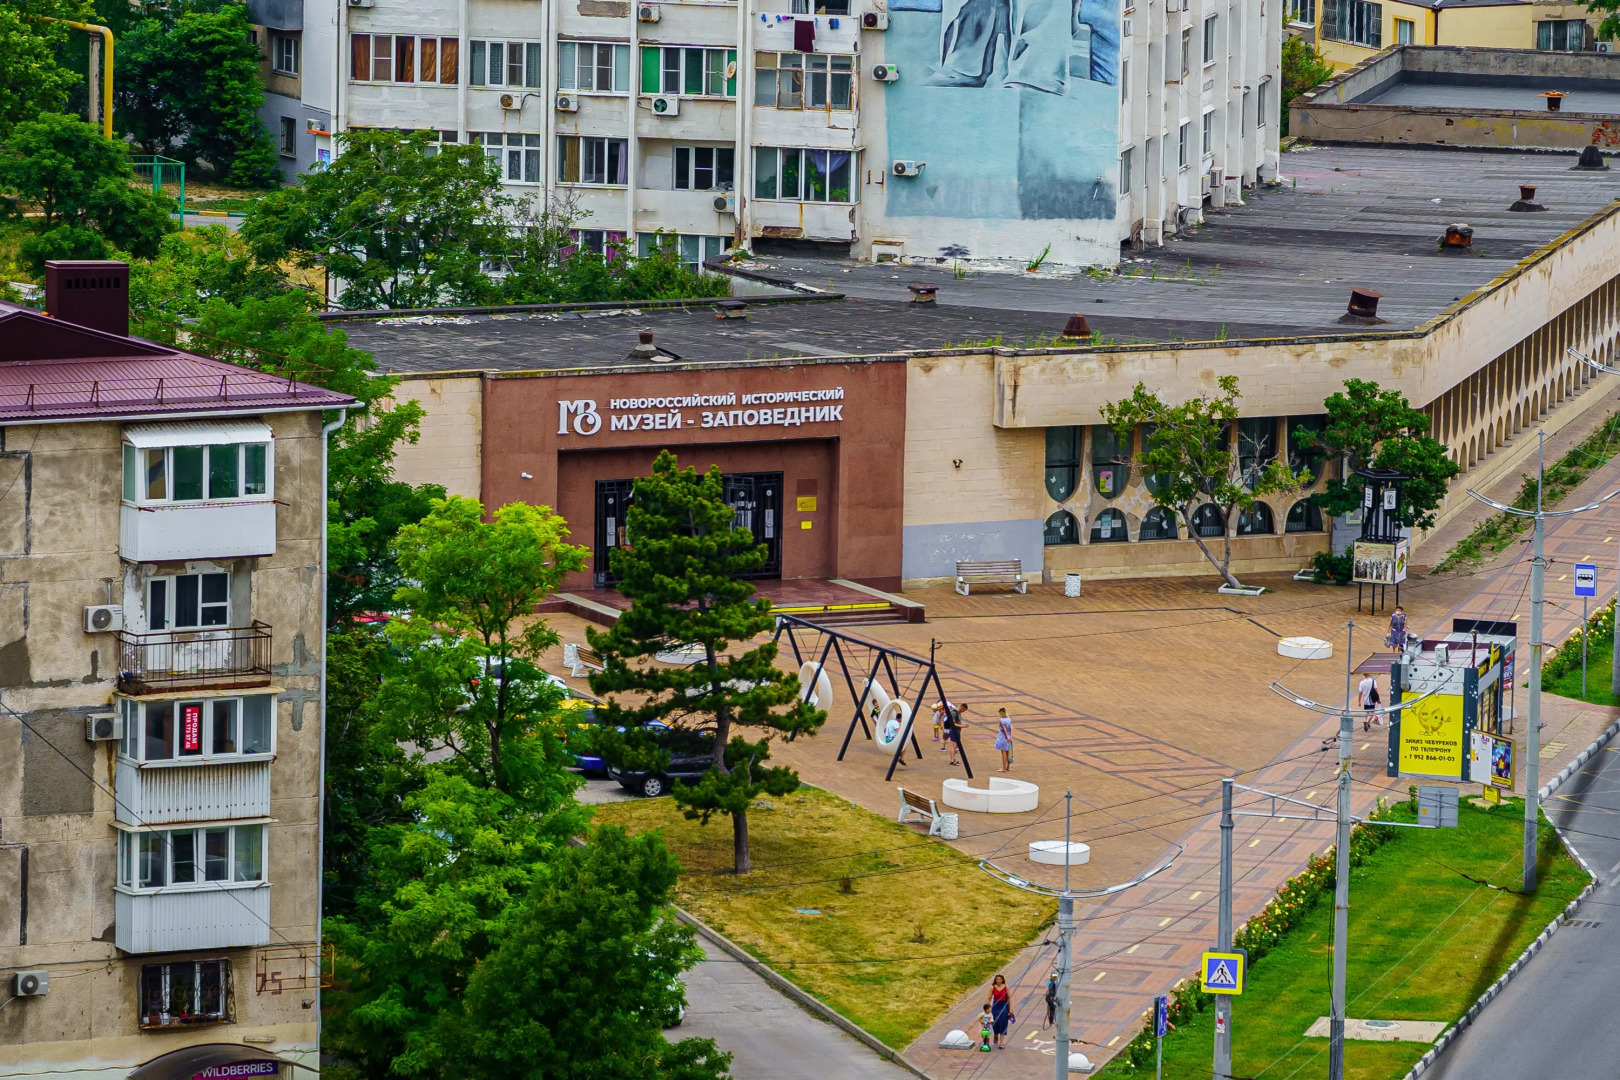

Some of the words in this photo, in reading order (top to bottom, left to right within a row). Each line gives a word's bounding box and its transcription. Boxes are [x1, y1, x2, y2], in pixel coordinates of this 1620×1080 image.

[610, 392, 736, 409] НОВОРОССИЙСКИЙ
[741, 386, 844, 405] ИСТОРИЧЕСКИЙ
[610, 409, 682, 431] МУЗЕЙ
[700, 405, 844, 428] ЗАПОВЕДНИК
[256, 971, 282, 996] 75
[202, 1062, 274, 1078] WILDBERRIES
